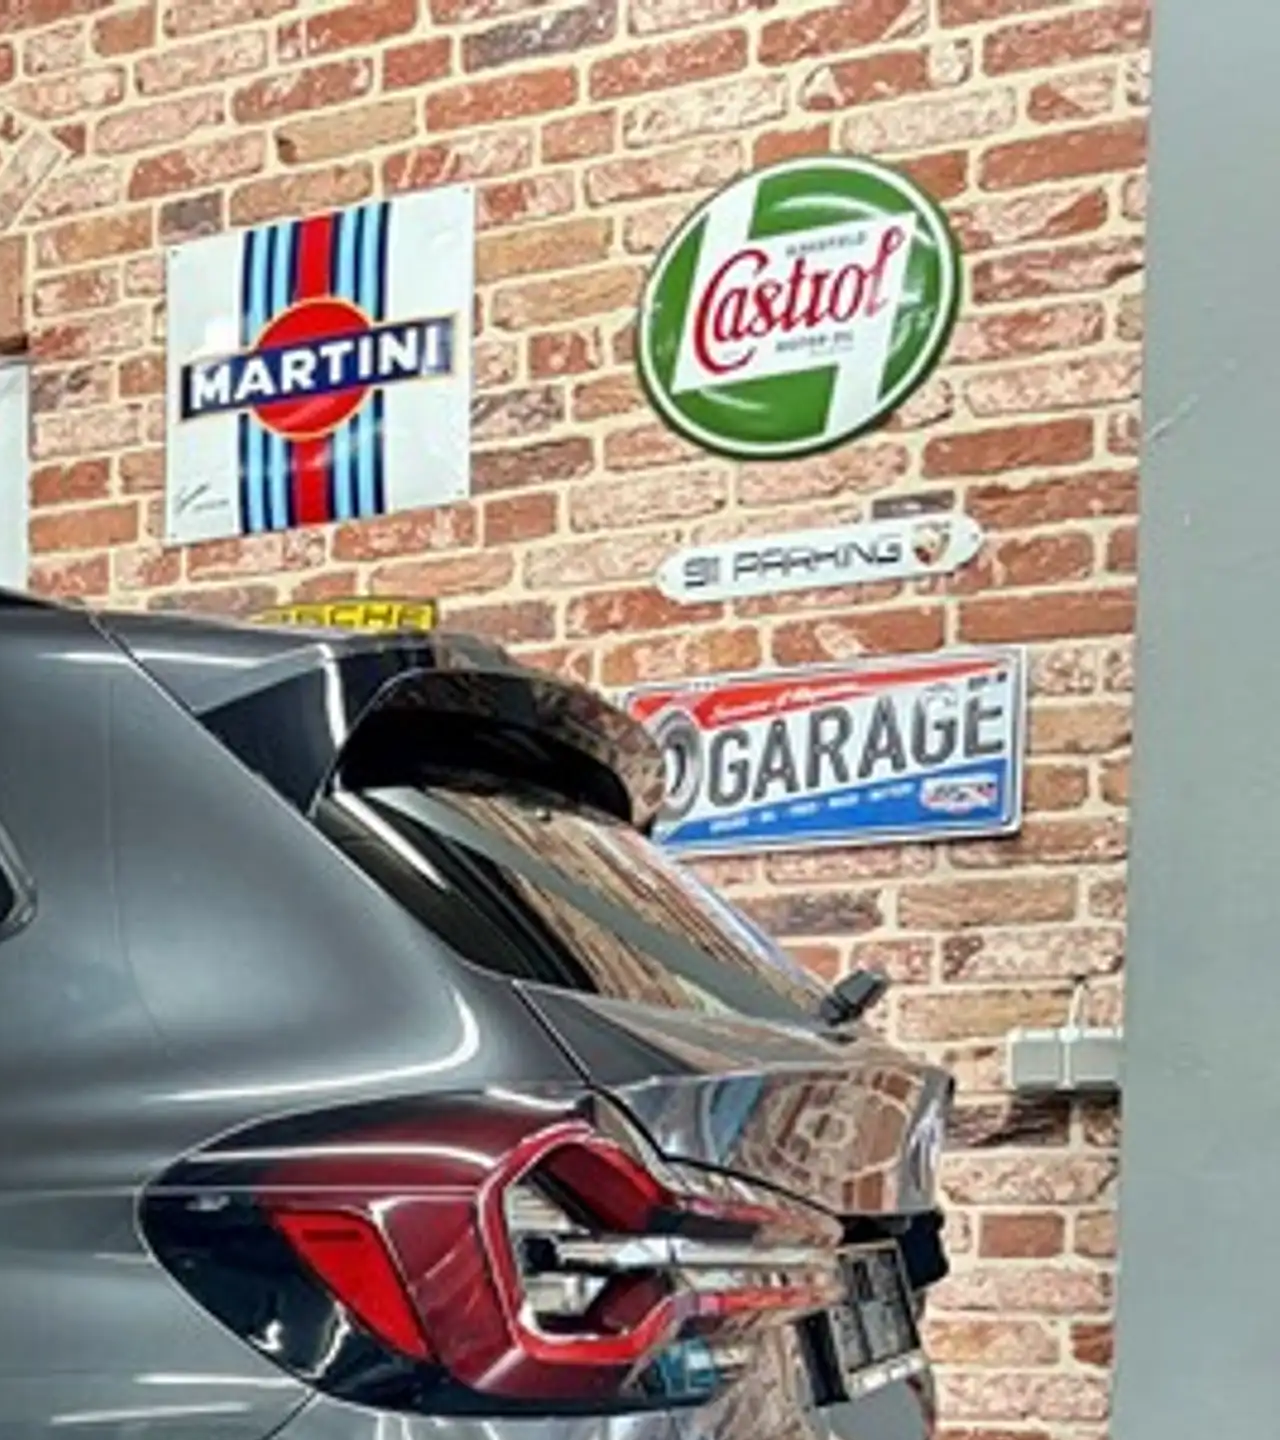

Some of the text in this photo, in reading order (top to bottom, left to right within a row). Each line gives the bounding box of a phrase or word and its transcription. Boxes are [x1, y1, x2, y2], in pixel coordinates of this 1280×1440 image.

[694, 225, 906, 374] Castrol
[193, 324, 437, 408] MARTINI
[732, 533, 902, 582] PARKING
[707, 676, 1005, 808] GARAGE
